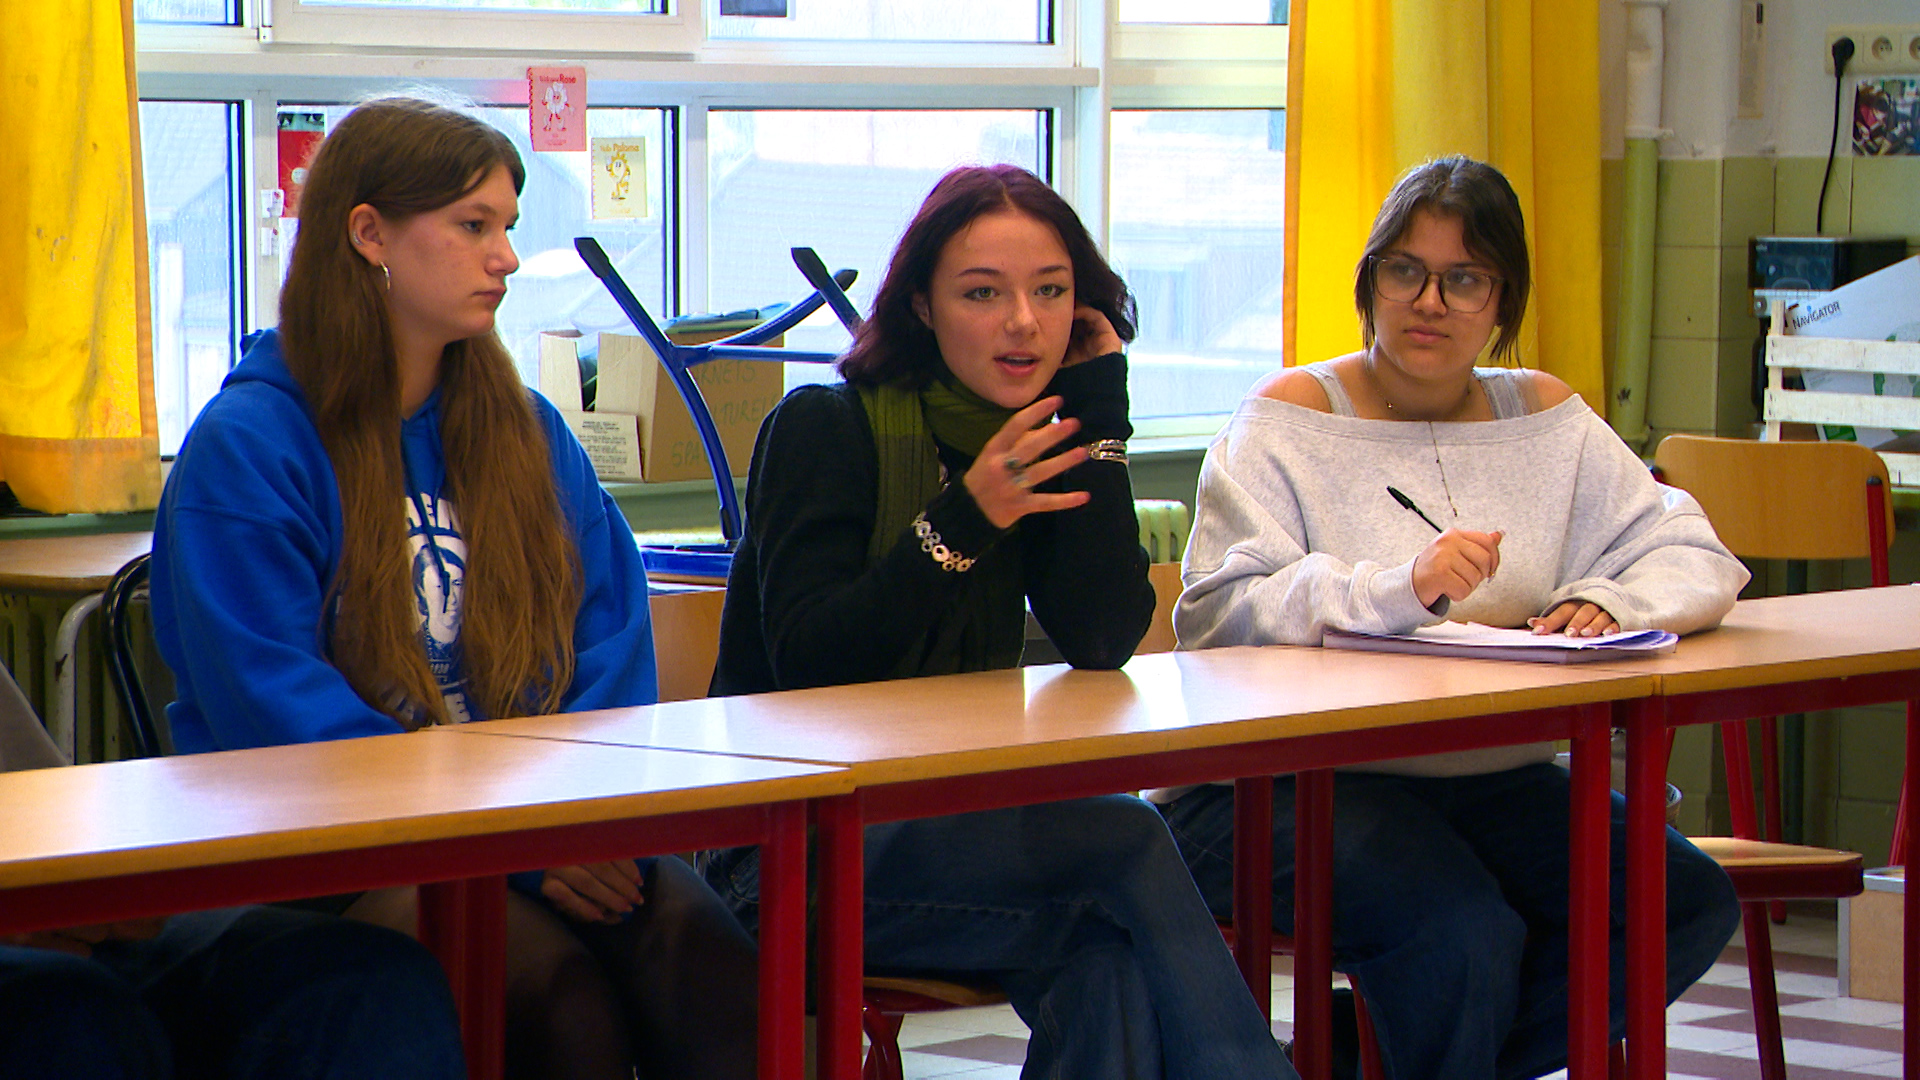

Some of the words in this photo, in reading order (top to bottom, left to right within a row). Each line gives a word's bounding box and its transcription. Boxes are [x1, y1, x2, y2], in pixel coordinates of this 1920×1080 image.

[559, 73, 577, 84] Rose
[613, 142, 640, 152] Paloma
[1792, 301, 1840, 329] NAVIGATOR
